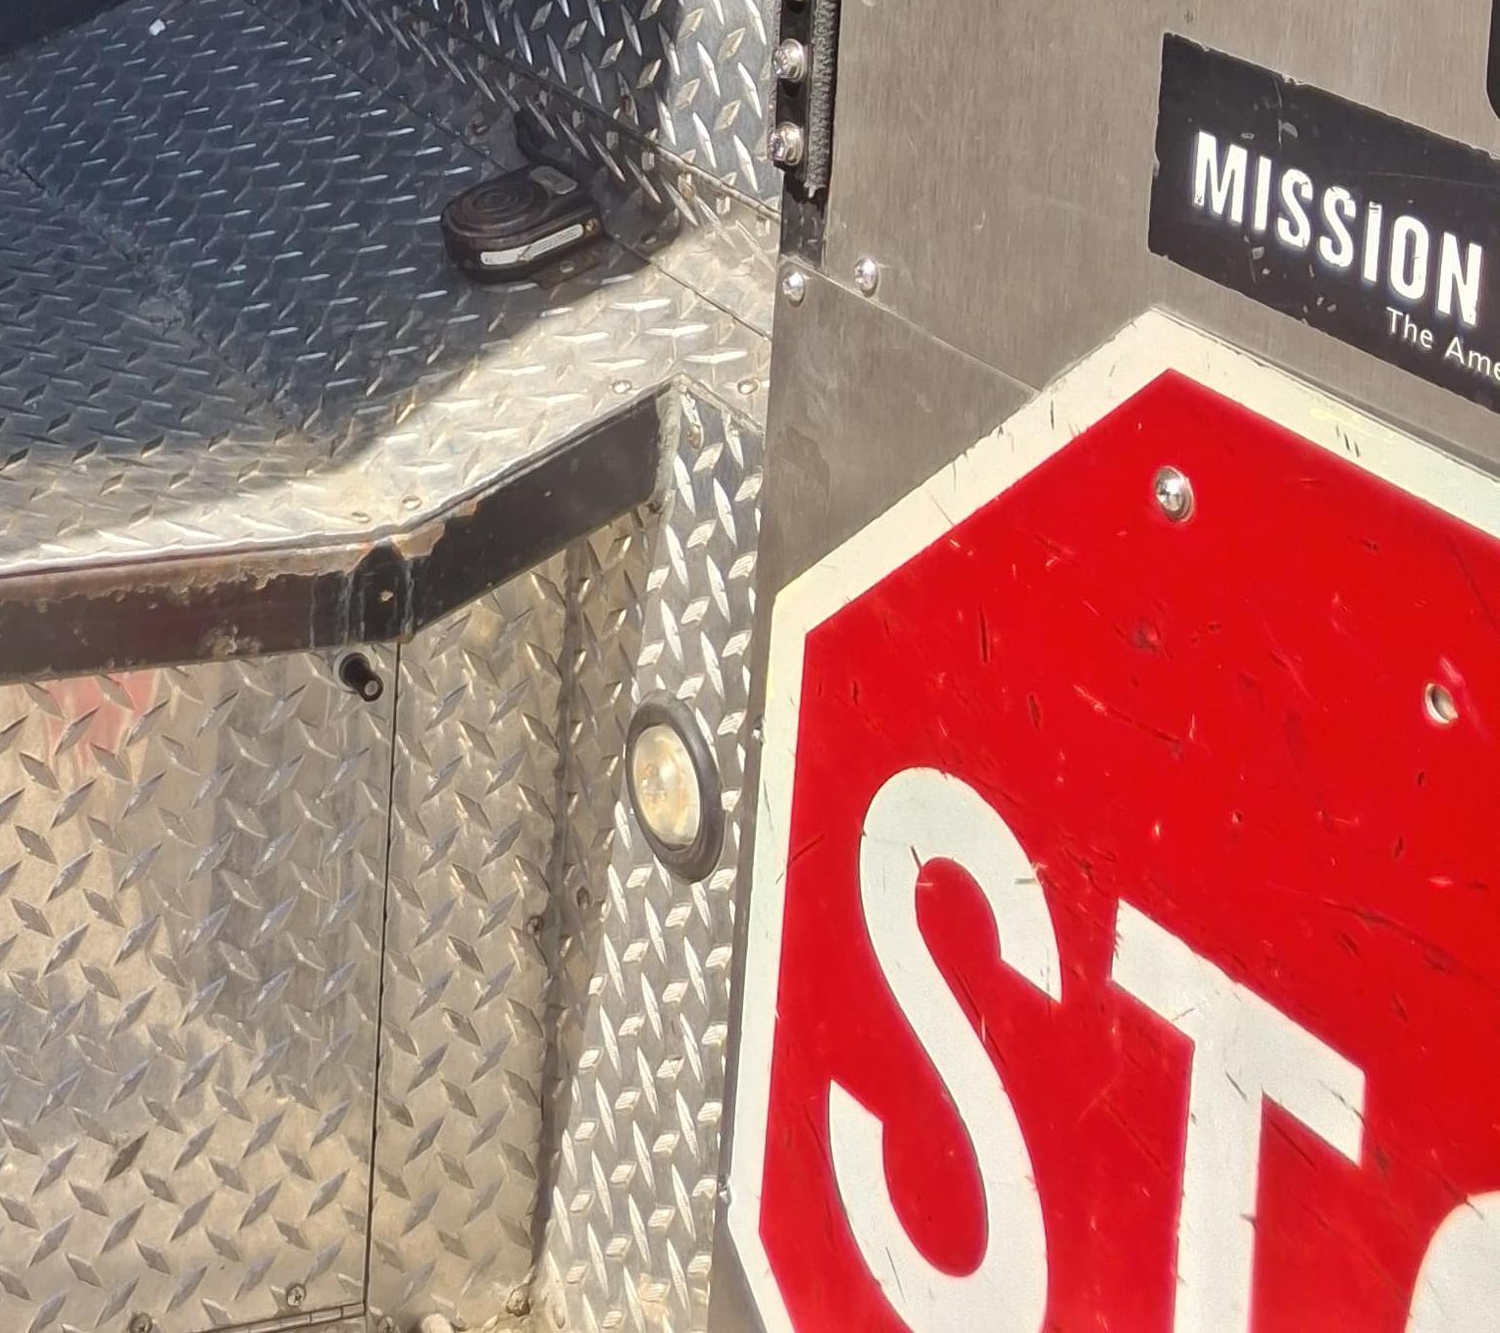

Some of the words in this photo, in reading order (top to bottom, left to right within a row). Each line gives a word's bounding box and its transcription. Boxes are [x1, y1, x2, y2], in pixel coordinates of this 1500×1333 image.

[1194, 130, 1482, 326] MISSION
[1386, 306, 1434, 349] The
[829, 766, 1500, 1333] ST
